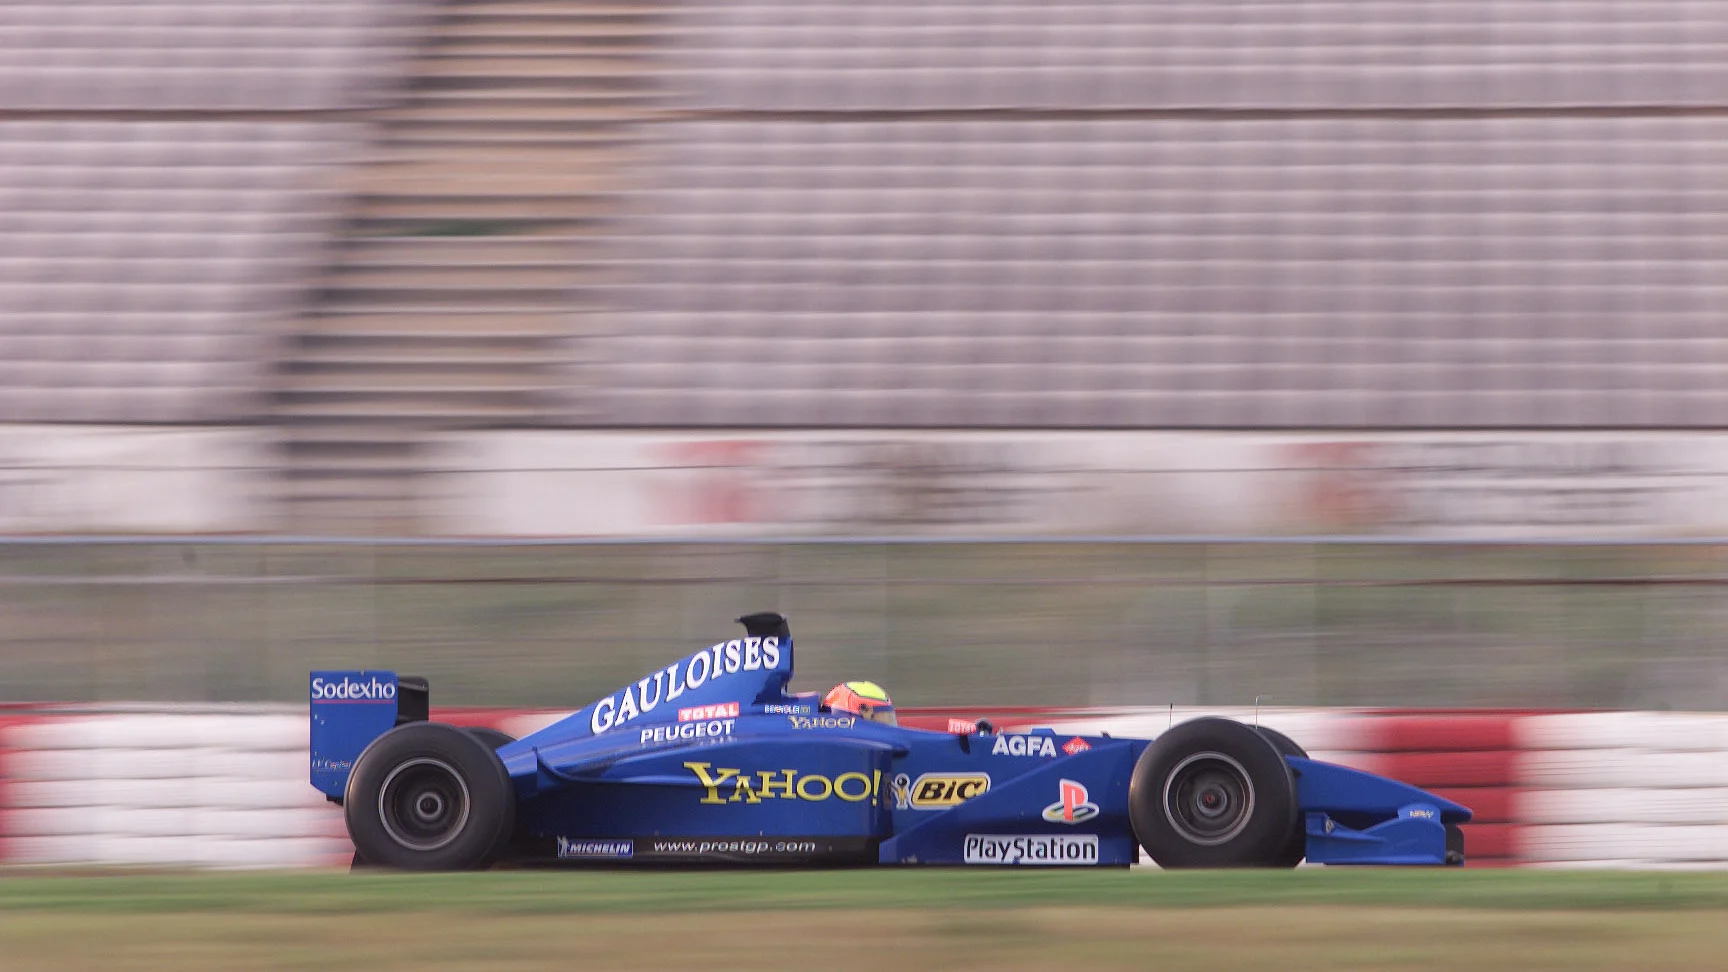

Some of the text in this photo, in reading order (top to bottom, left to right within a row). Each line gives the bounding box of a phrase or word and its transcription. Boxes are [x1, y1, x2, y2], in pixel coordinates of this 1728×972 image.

[311, 677, 396, 699] Sodexho
[590, 635, 780, 735] GAULOISES
[680, 703, 737, 721] TOTAL
[640, 719, 735, 744] PEUGEOT
[991, 735, 1057, 757] AGFA
[569, 842, 631, 854] MICHELIN
[653, 840, 816, 854] www.prostgp.com
[966, 837, 1096, 861] PlayStation
